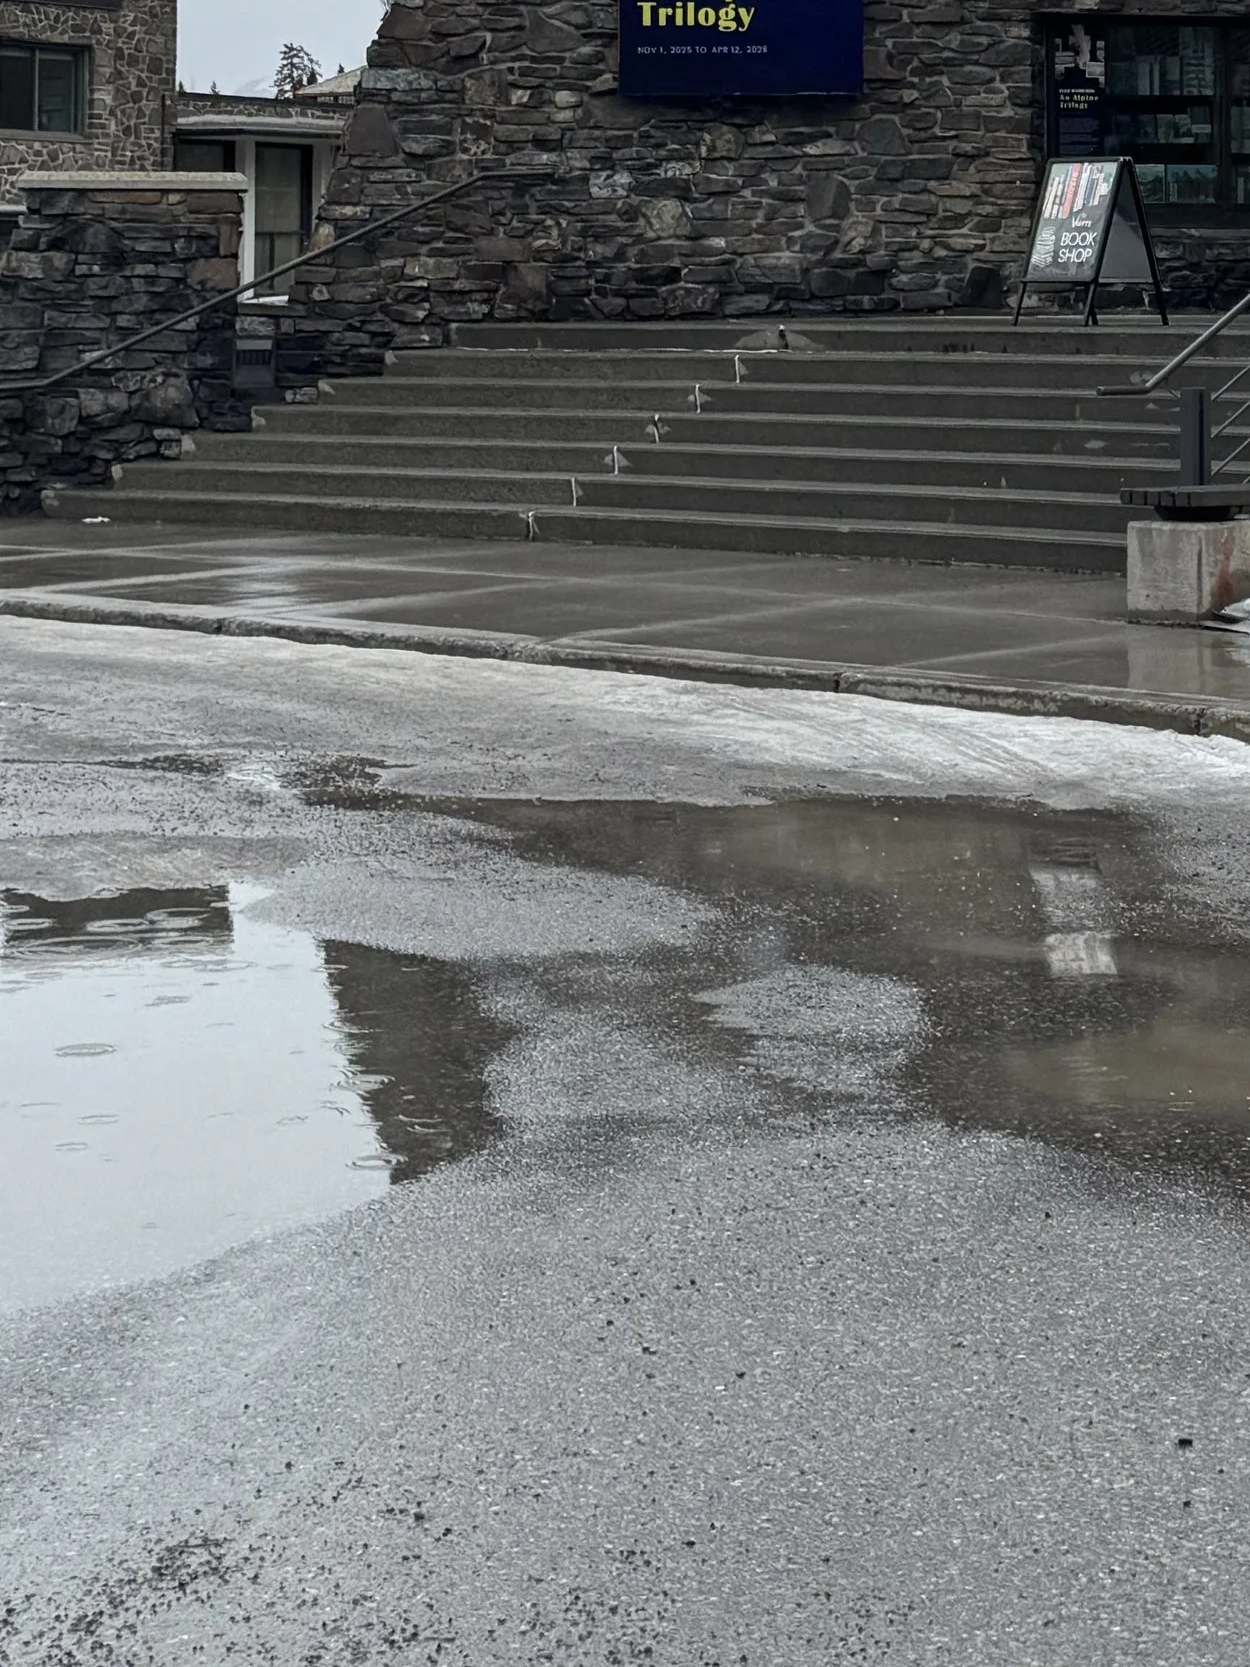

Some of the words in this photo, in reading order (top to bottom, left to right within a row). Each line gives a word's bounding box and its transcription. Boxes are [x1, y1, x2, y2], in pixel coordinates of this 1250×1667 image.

[637, 2, 755, 32] Trilogy
[637, 46, 657, 54] NOV
[695, 46, 707, 54] TO
[712, 46, 729, 54] APR
[1060, 232, 1098, 246] BOOK
[1058, 248, 1093, 263] SHOP
